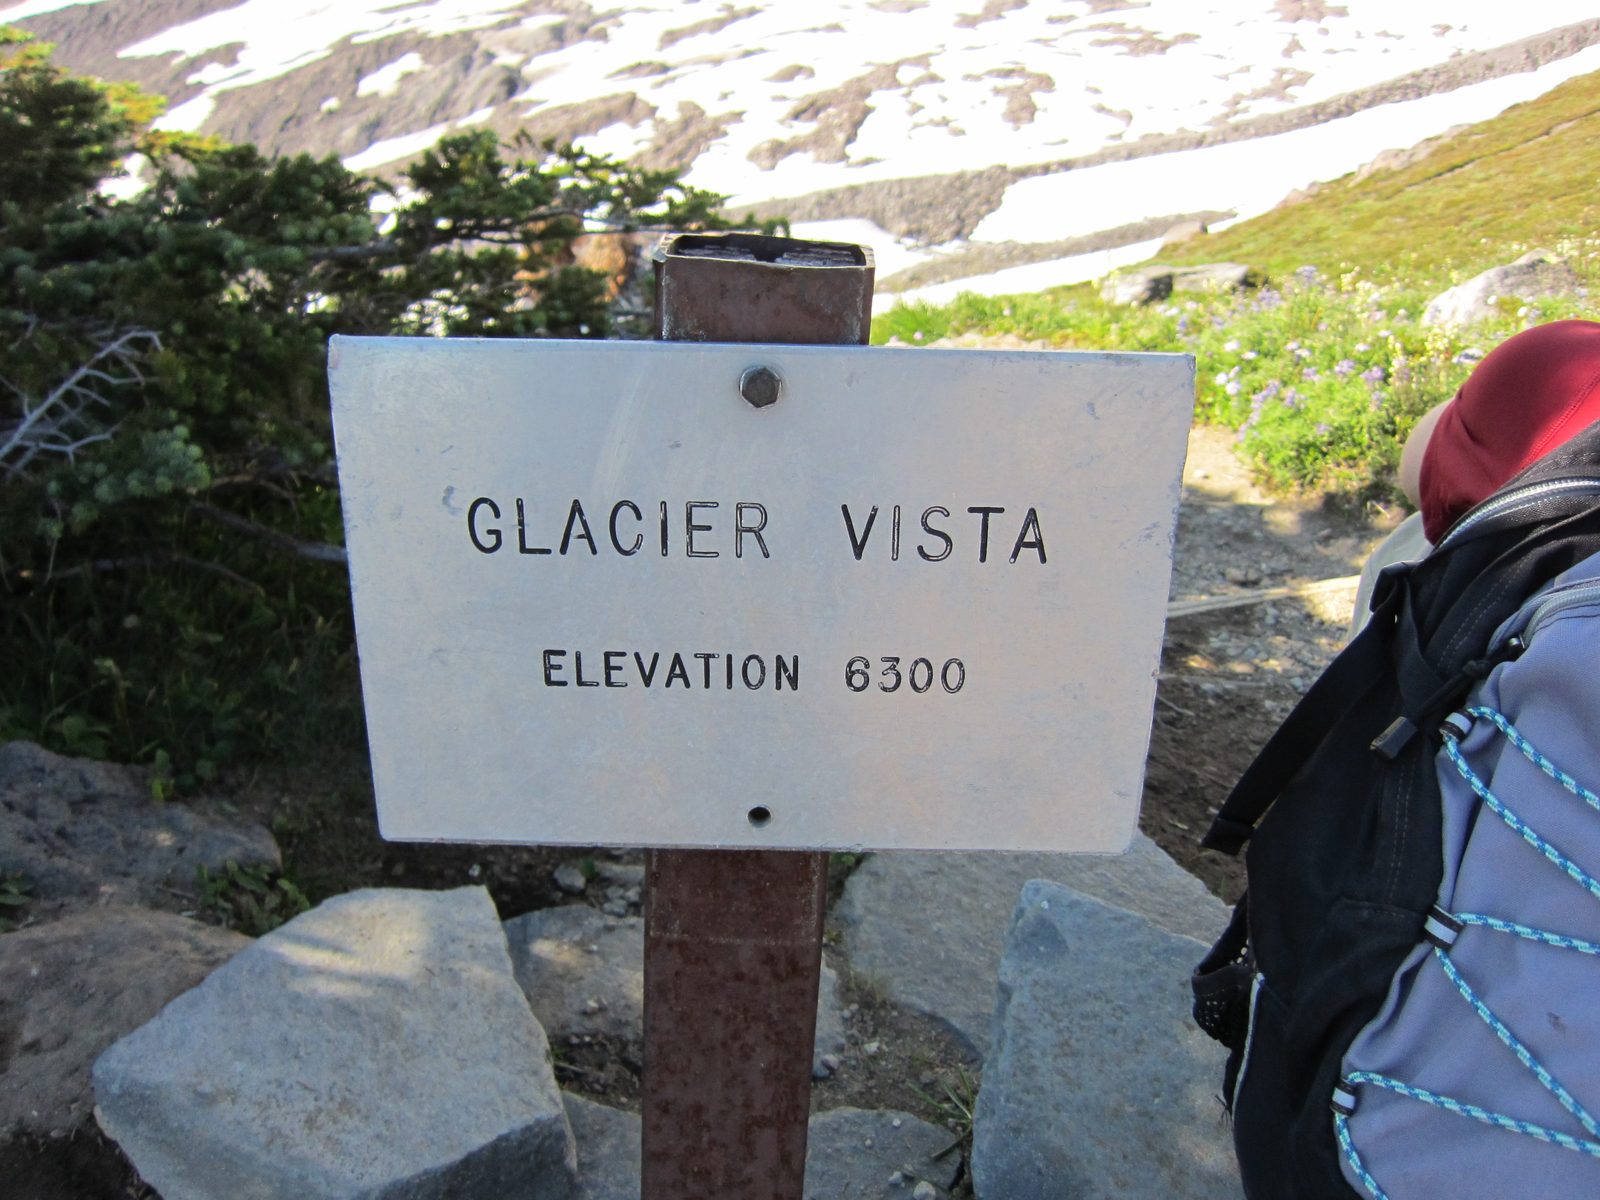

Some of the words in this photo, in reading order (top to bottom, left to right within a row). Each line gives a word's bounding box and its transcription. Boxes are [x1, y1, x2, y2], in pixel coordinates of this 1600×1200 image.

[468, 496, 770, 559] GLACIER
[841, 503, 1048, 565] VISTA
[543, 649, 799, 692] ELEVATION
[845, 656, 966, 695] 6300
